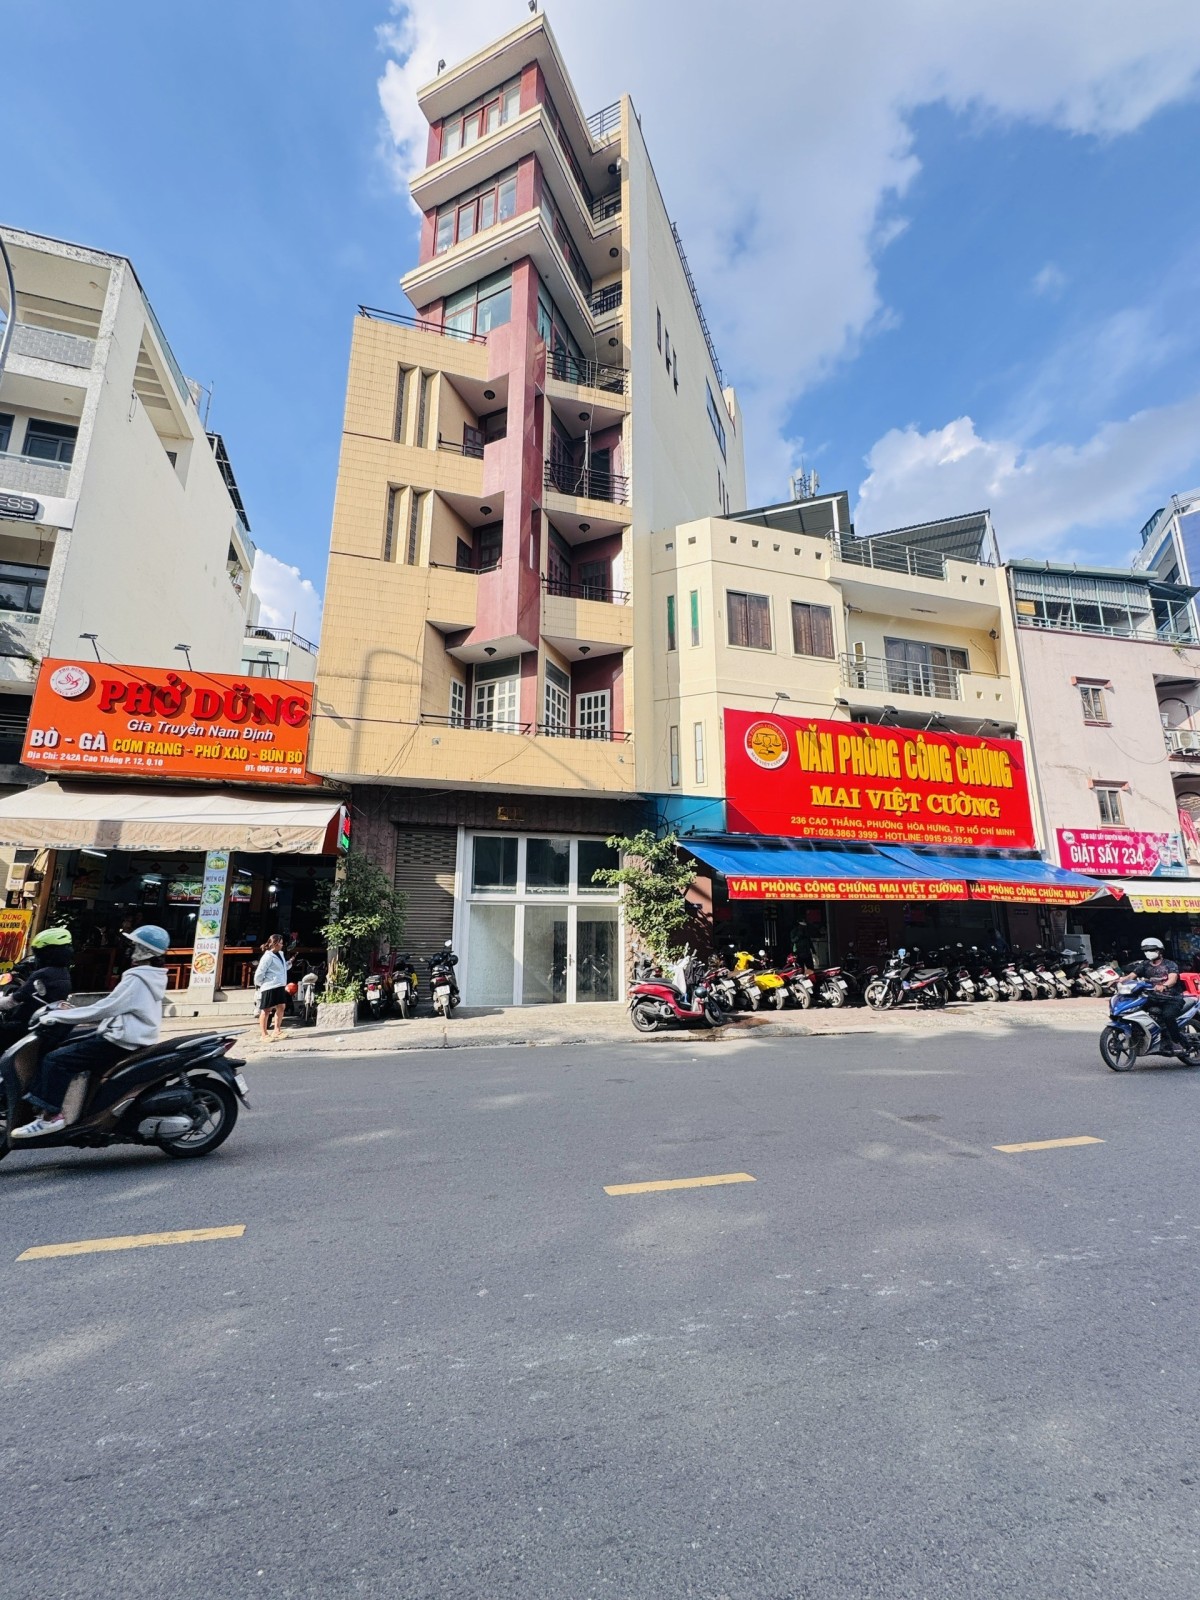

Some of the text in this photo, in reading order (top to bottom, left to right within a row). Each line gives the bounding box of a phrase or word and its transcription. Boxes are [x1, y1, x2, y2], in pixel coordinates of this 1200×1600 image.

[97, 673, 308, 726] PHỞ DŨNG
[29, 727, 60, 748] BÒ
[78, 730, 107, 751] GÀ
[127, 719, 274, 742] Gia Truyền Nam Định
[60, 752, 81, 762] 242A
[82, 755, 98, 763] Cao
[112, 738, 143, 754] CƠM
[145, 740, 183, 756] RANG
[286, 750, 304, 764] BÒ
[795, 725, 1014, 788] VĂN PHÒNG CÔNG CHỨNG
[256, 765, 274, 773] 0967
[274, 766, 287, 774] 922
[810, 785, 1001, 818] MAI VIỆT CƯỜNG
[790, 816, 807, 825] 236
[808, 817, 828, 826] CAO
[866, 820, 904, 830] PHƯỜNG
[906, 821, 925, 831] HÒA
[926, 824, 953, 834] HƯNG,
[954, 825, 966, 834] TP.
[980, 826, 994, 835] CHÍ
[995, 828, 1016, 836] MINH
[858, 830, 878, 839] 3999
[924, 834, 942, 843] 0915
[1070, 842, 1144, 866] GIẶT SẤY 234
[731, 880, 964, 894] VĂN PHÒNG CÔNG CHỨNG MAI VIỆT CƯỜNG
[969, 884, 986, 893] VĂN
[988, 884, 1015, 895] PHÒNG
[1016, 886, 1038, 896] CÔNG
[1039, 887, 1065, 897] CHỨNG
[1065, 889, 1079, 898] MAI
[861, 904, 881, 913] 236
